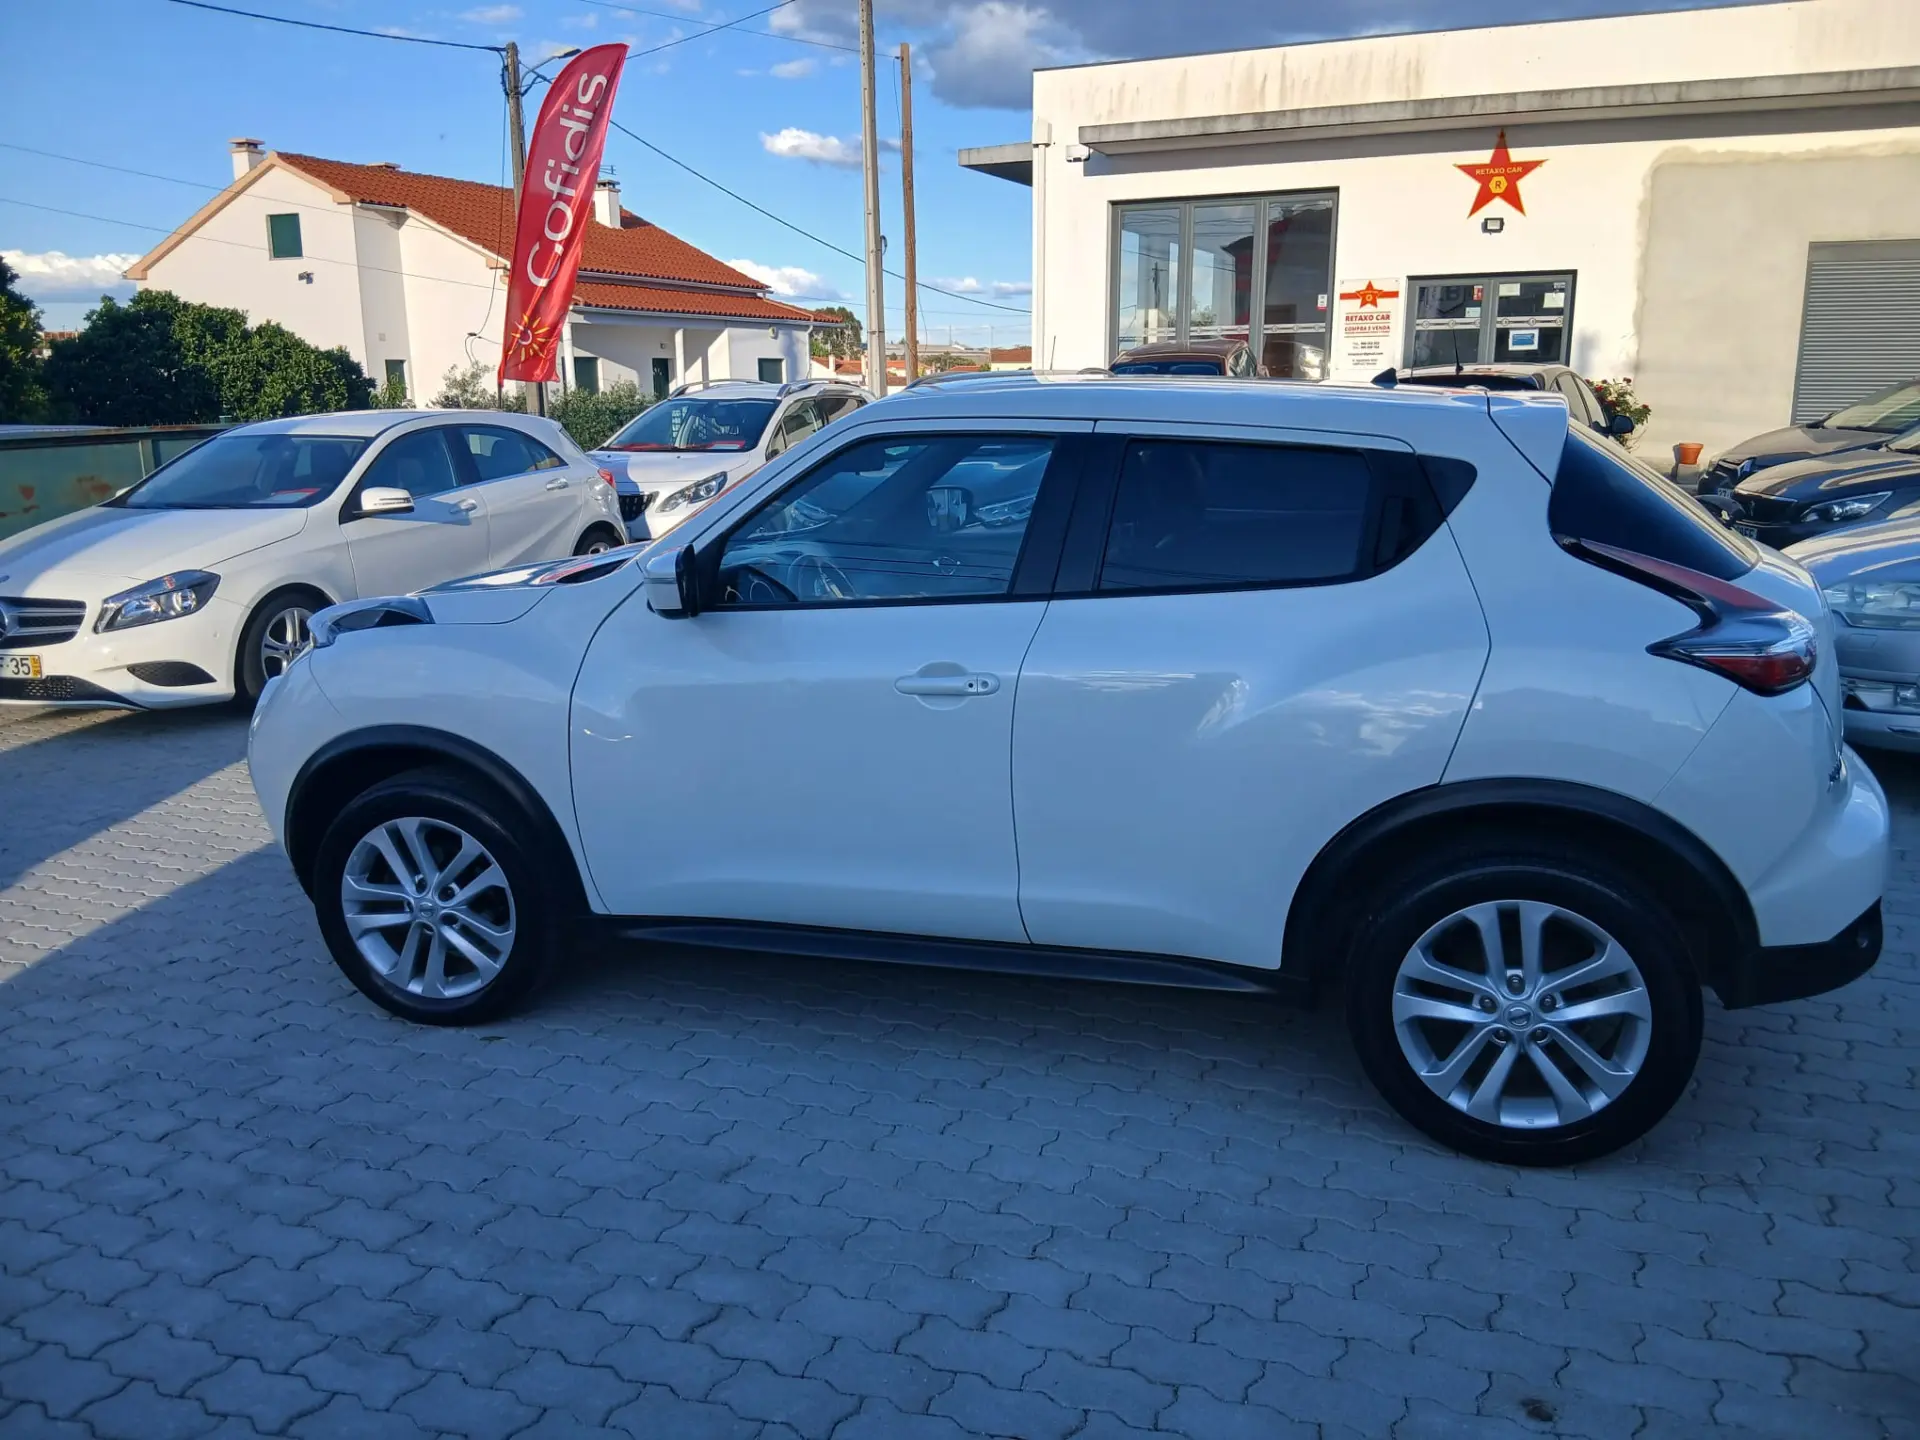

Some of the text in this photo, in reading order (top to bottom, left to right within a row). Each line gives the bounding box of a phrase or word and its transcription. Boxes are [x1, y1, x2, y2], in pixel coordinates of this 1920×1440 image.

[1475, 166, 1523, 175] RETAXO CAR
[526, 72, 608, 288] Cofidis
[1494, 180, 1502, 189] R
[1345, 314, 1374, 322] RETAXO
